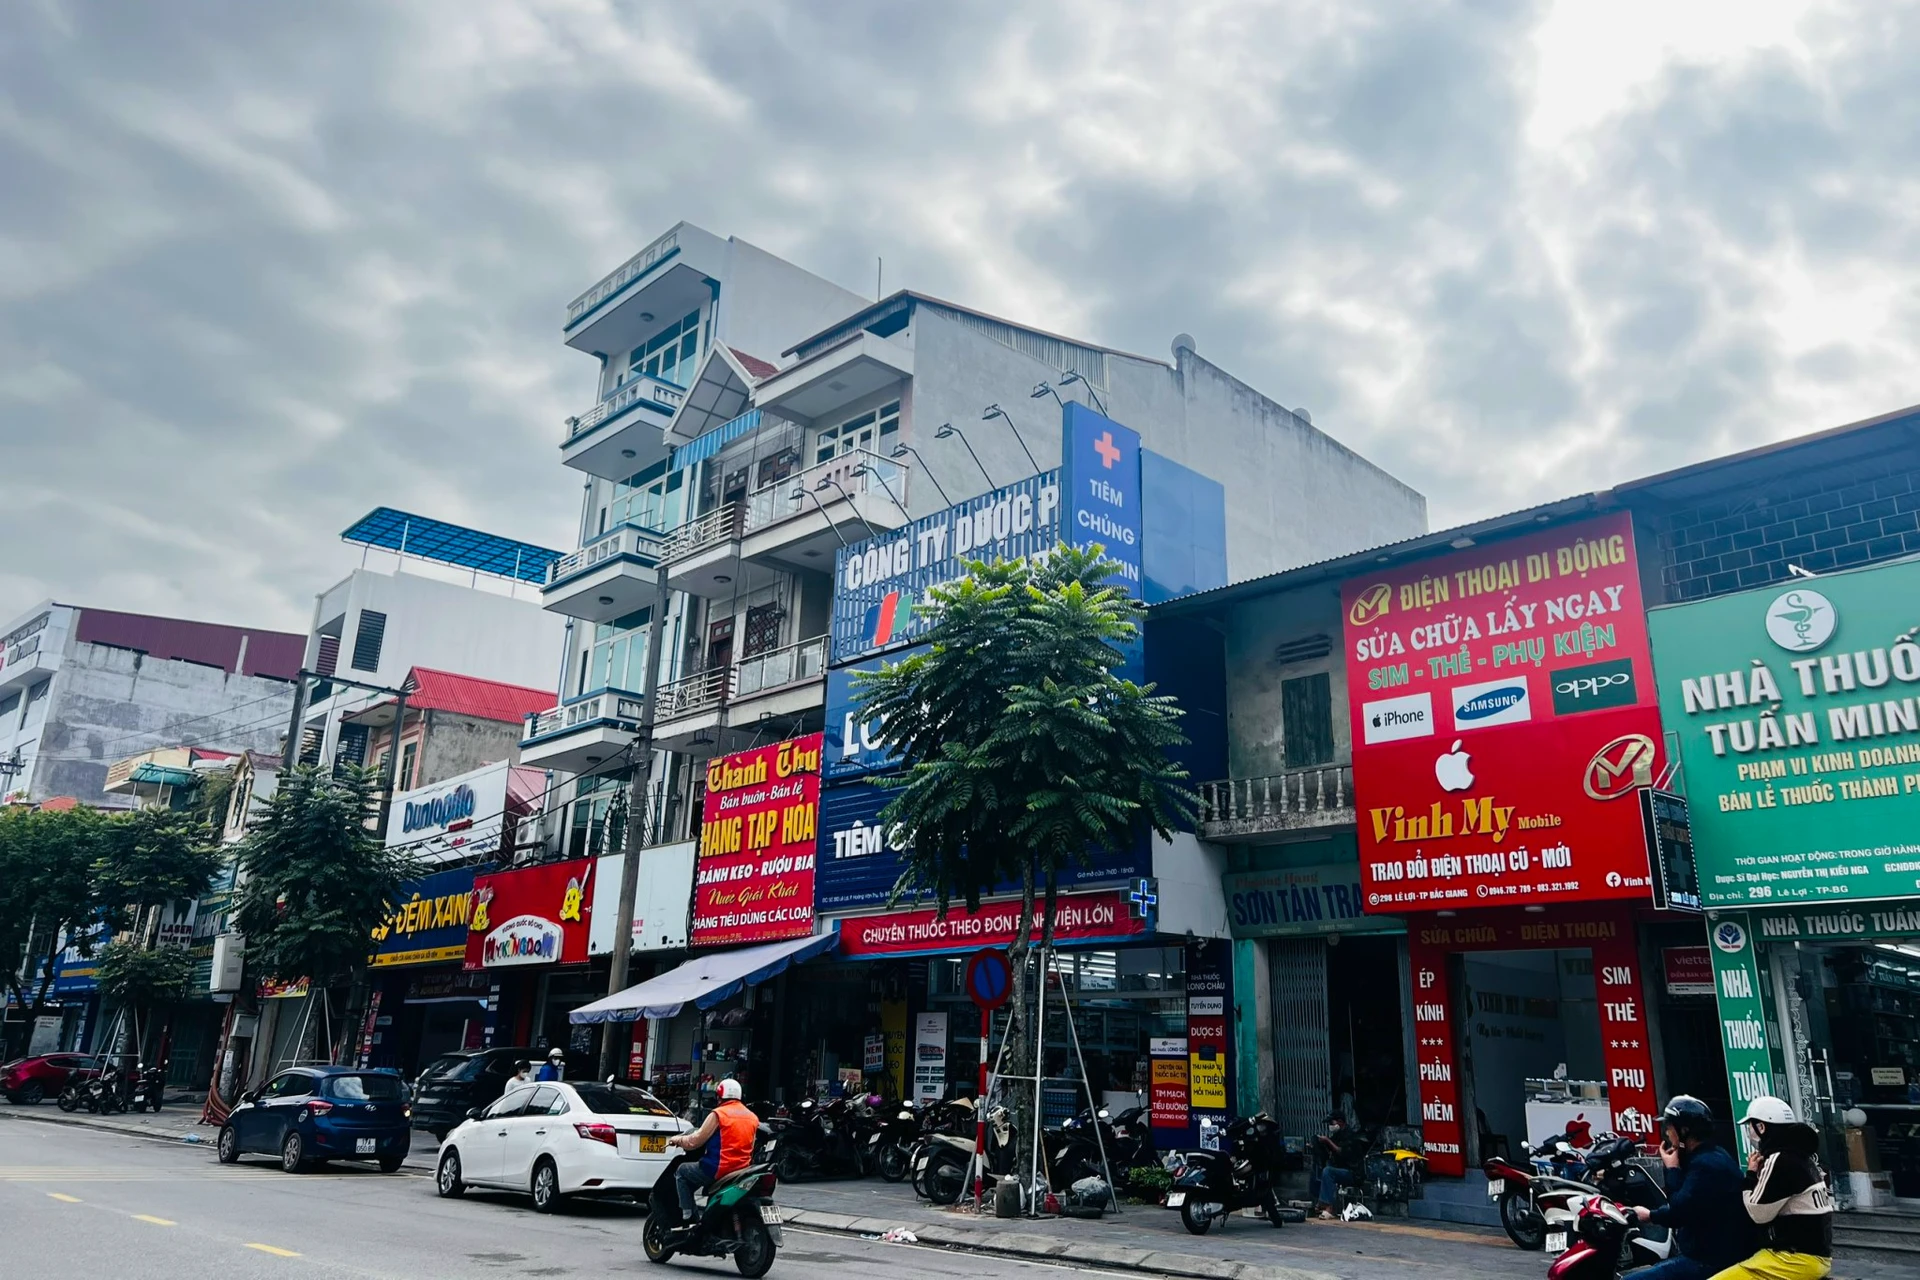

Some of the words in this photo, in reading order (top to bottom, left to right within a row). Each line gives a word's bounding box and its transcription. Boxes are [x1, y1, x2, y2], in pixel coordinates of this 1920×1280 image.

[1089, 478, 1123, 508] TIÊM
[847, 537, 909, 591] CÔNG
[917, 523, 949, 567] TY
[956, 490, 1031, 555] DƯỢC
[1078, 508, 1135, 547] CHỦNG
[1400, 574, 1450, 612] ĐIỆN
[1455, 559, 1520, 597] THOẠI
[1527, 552, 1550, 582] DI
[1557, 534, 1626, 578] ĐỘNG
[1356, 627, 1405, 662] SỬA
[1410, 612, 1481, 652] CHỮA
[1487, 595, 1538, 637] LẤY
[1545, 584, 1625, 625] NGAY
[1368, 663, 1409, 690] SIM
[1428, 644, 1472, 680] THẺ
[1492, 637, 1546, 668] PHỤ
[1554, 622, 1617, 659] KIỆN
[1555, 673, 1630, 698] oppo
[1681, 658, 1783, 714] NHÀ
[1463, 694, 1518, 713] SAMSUNG
[1384, 708, 1424, 727] iPhone
[1705, 703, 1819, 755] TUẤN
[707, 755, 767, 793] Thành
[776, 742, 818, 778] Thu
[1737, 762, 1787, 783] PHẠM
[1790, 758, 1808, 776] VI
[1812, 752, 1855, 773] KINH
[1858, 744, 1920, 769] DOANH
[719, 790, 739, 810] Bán
[1718, 788, 1752, 812] BÁN
[1757, 783, 1777, 809] LẺ
[1780, 778, 1834, 806] THUỐC
[1839, 776, 1899, 800] THÀNH
[403, 784, 475, 834] Dunlopillo
[1369, 801, 1454, 844] Vinh
[1459, 796, 1515, 843] My
[1518, 813, 1561, 830] Mobile
[700, 812, 742, 857] HÀNG
[747, 809, 778, 856] TẠP
[781, 794, 815, 845] HÓA
[833, 820, 882, 859] TIÊM
[699, 865, 730, 885] BÁNH
[761, 854, 793, 878] RƯỢU
[794, 853, 814, 871] BIA
[1370, 862, 1403, 882] TRAO
[1406, 849, 1428, 880] ĐỔI
[1431, 854, 1462, 880] ĐIỆN
[1465, 852, 1507, 877] THOẠI
[1509, 846, 1529, 871] CŨ
[1541, 841, 1572, 868] MỚI
[1735, 857, 1756, 866] THỜI
[1757, 855, 1779, 865] GIAN
[1781, 853, 1806, 864] HOẠT
[1808, 851, 1837, 862] ĐỘNG:
[1839, 849, 1872, 859] TRONG
[1874, 846, 1891, 857] GIỜ
[1623, 876, 1643, 887] Vinh
[1780, 866, 1813, 879] NGUYỄN
[1815, 866, 1829, 879] THỊ
[1851, 864, 1869, 875] NGA
[767, 880, 798, 900] Khát
[1395, 891, 1403, 901] LÊ
[1445, 888, 1468, 898] GIANG
[1749, 886, 1772, 898] 296
[1777, 888, 1789, 897] Lê
[1791, 887, 1808, 897] Lợi
[395, 892, 432, 939] ĐỆM
[694, 914, 718, 929] HÀNG
[719, 909, 740, 927] TIÊU
[740, 907, 766, 924] DÙNG
[768, 905, 788, 922] CÁC
[789, 906, 811, 922] LOẠI
[1233, 890, 1278, 926] SƠN
[1277, 883, 1322, 923] TÂN
[162, 924, 192, 934] LASER
[862, 923, 906, 943] CHUYÊN
[907, 917, 947, 940] THUỐC
[949, 918, 980, 935] THEO
[984, 914, 1012, 933] ĐƠN
[1085, 903, 1114, 924] LỚN
[1421, 924, 1450, 945] SỬA
[1455, 922, 1497, 943] CHỮA
[1521, 921, 1560, 943] ĐIỆN
[1564, 920, 1616, 942] THOẠI
[1761, 912, 1800, 937] NHÀ
[1804, 907, 1866, 934] THUỐC
[1869, 904, 1920, 933] TUẤN
[1187, 982, 1206, 990] LONG
[1206, 980, 1225, 990] CHÂU
[1419, 967, 1435, 988] ÉP
[1602, 966, 1631, 985] SIM
[1720, 963, 1753, 999] NHÀ
[1207, 1002, 1222, 1010] DỤNG
[1416, 1001, 1444, 1022] KÍNH
[1604, 997, 1637, 1022] THẺ
[1191, 1026, 1214, 1039] DƯỢC
[1215, 1025, 1223, 1037] SĨ
[1724, 1009, 1764, 1050] THUỐC
[1193, 1075, 1200, 1083] 10
[1202, 1073, 1224, 1087] TRIỆU
[1420, 1056, 1451, 1081] PHẦN
[1611, 1068, 1645, 1092] PHỤ
[1732, 1061, 1769, 1102] TUẤN
[1155, 1089, 1166, 1097] TIM
[1423, 1095, 1454, 1122] MỀM
